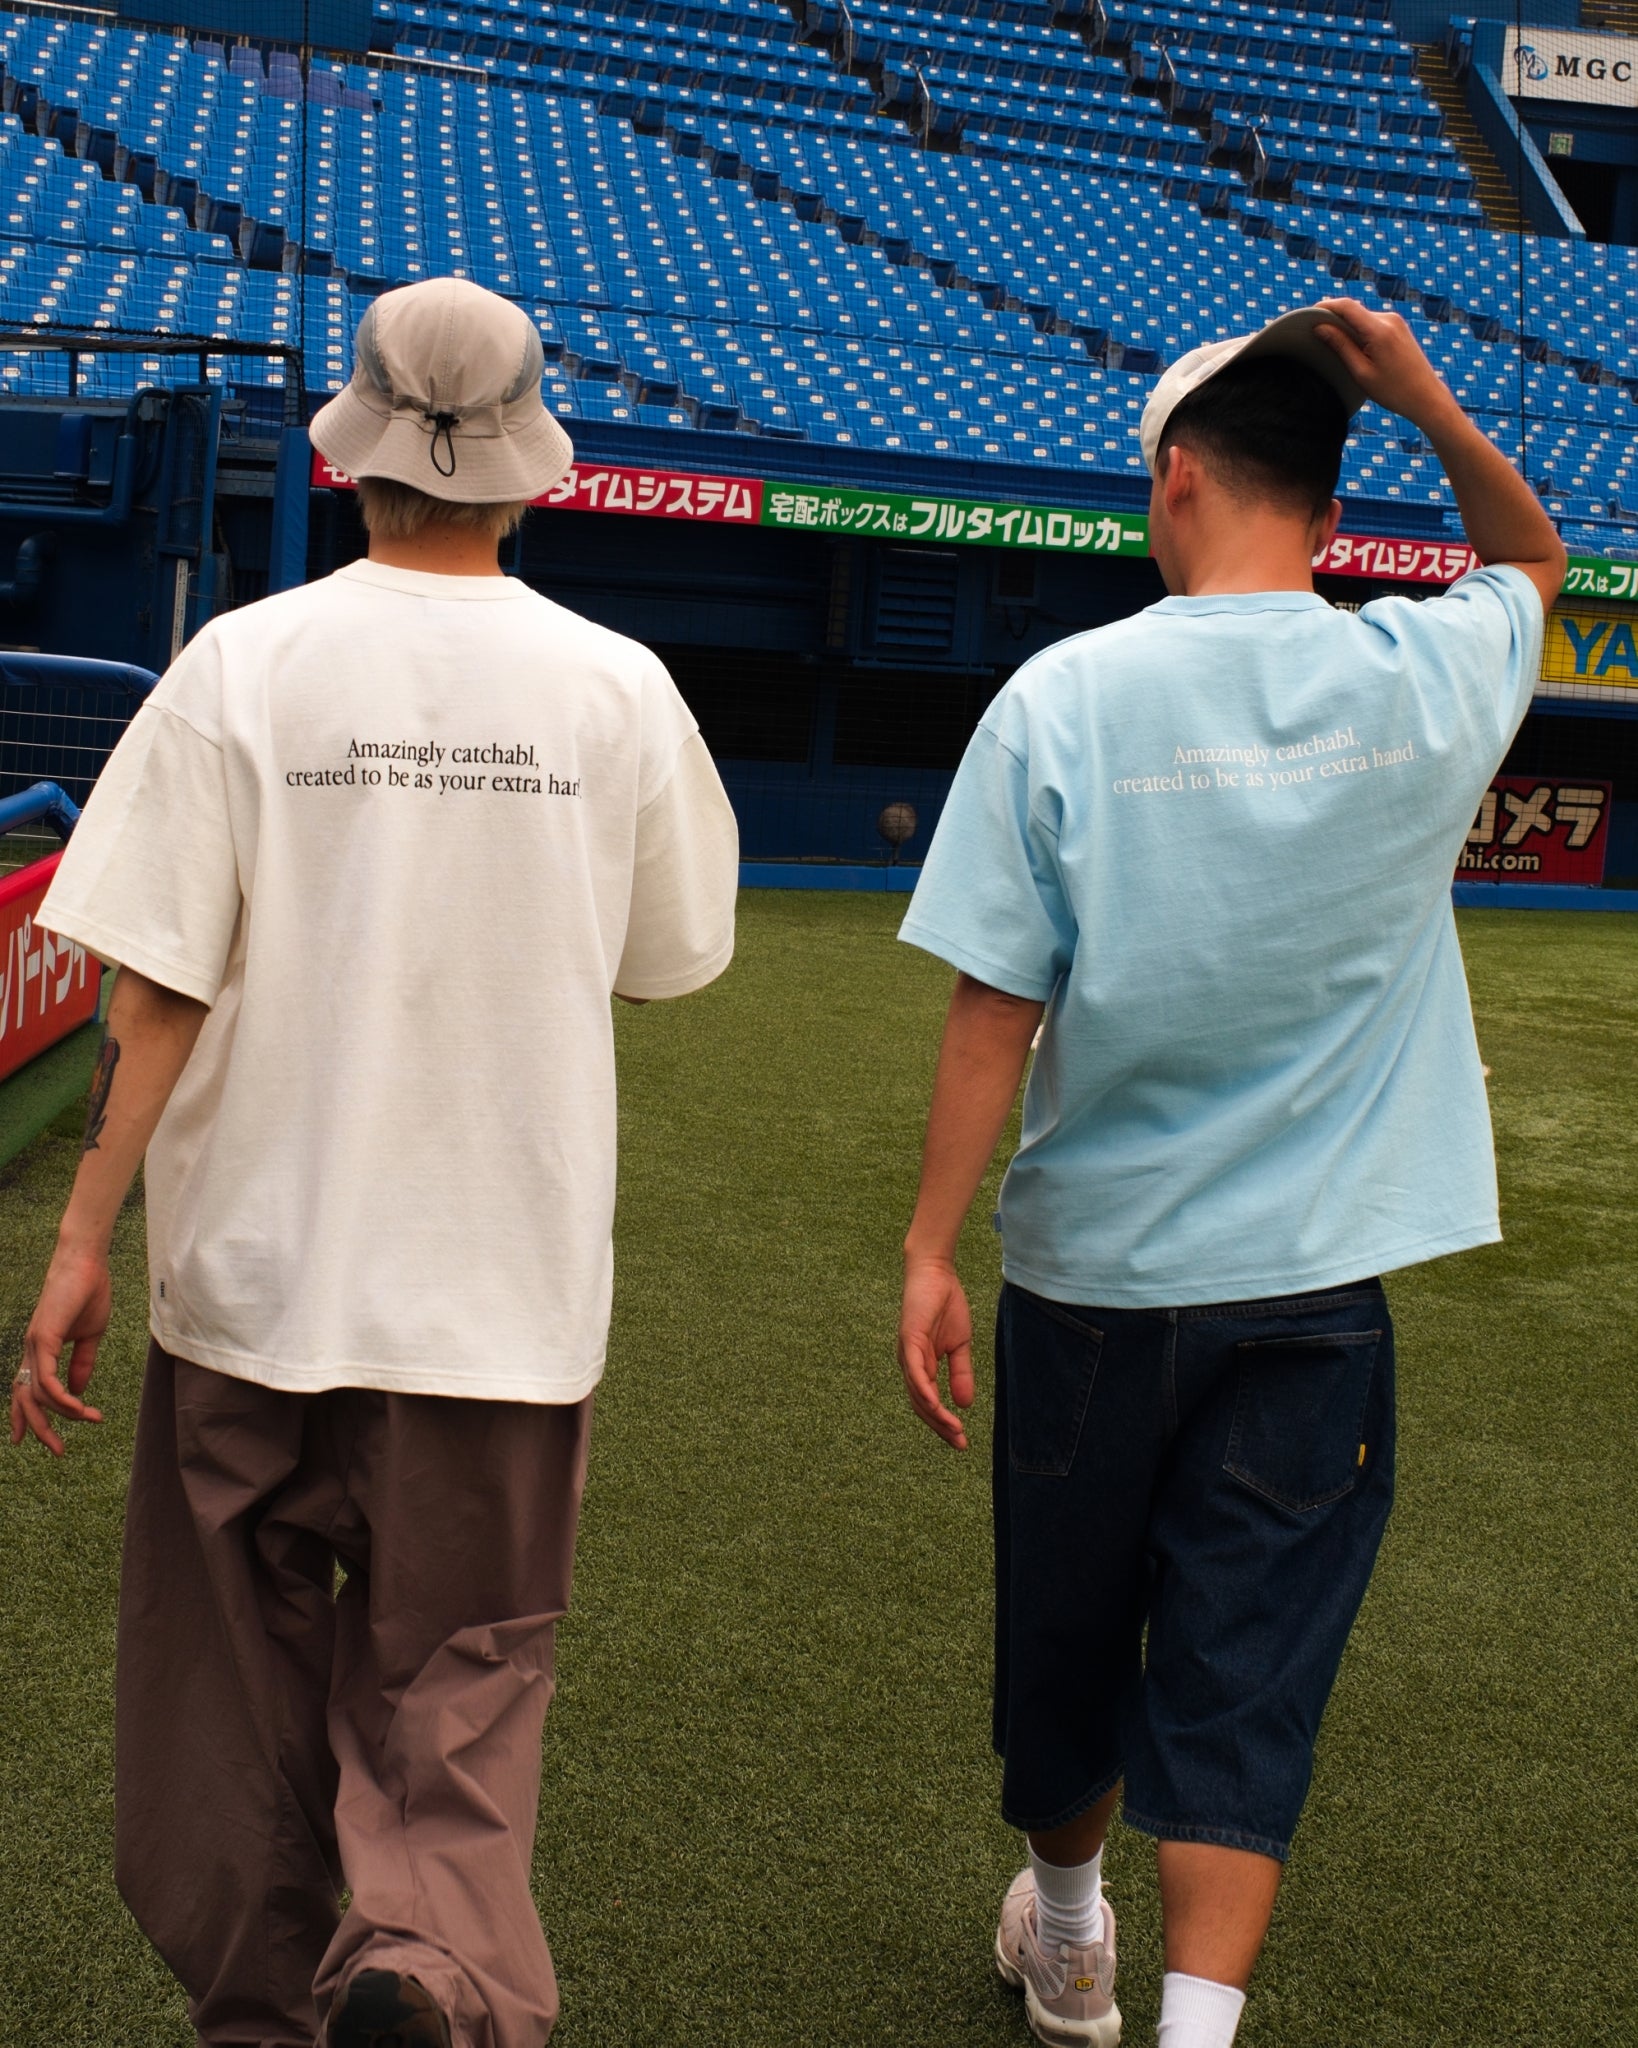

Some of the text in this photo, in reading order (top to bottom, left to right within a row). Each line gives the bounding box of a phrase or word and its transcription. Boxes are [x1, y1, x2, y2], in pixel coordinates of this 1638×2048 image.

[1555, 55, 1632, 82] MGC
[769, 492, 1144, 551] 宅配ボックスはフルタイムロッカー
[1564, 565, 1638, 598] クスはフ
[1560, 618, 1638, 678] YA
[347, 738, 541, 771] Amazingly catchabl,
[1173, 727, 1361, 768] Amazingly catchabl,
[285, 765, 355, 787] created
[361, 767, 382, 787] to
[387, 765, 410, 788] be
[414, 773, 434, 790] as
[438, 773, 487, 796] your
[491, 775, 542, 795] extra
[1112, 740, 1420, 795] created to be as your extra hand.
[1457, 846, 1541, 871] hi.com
